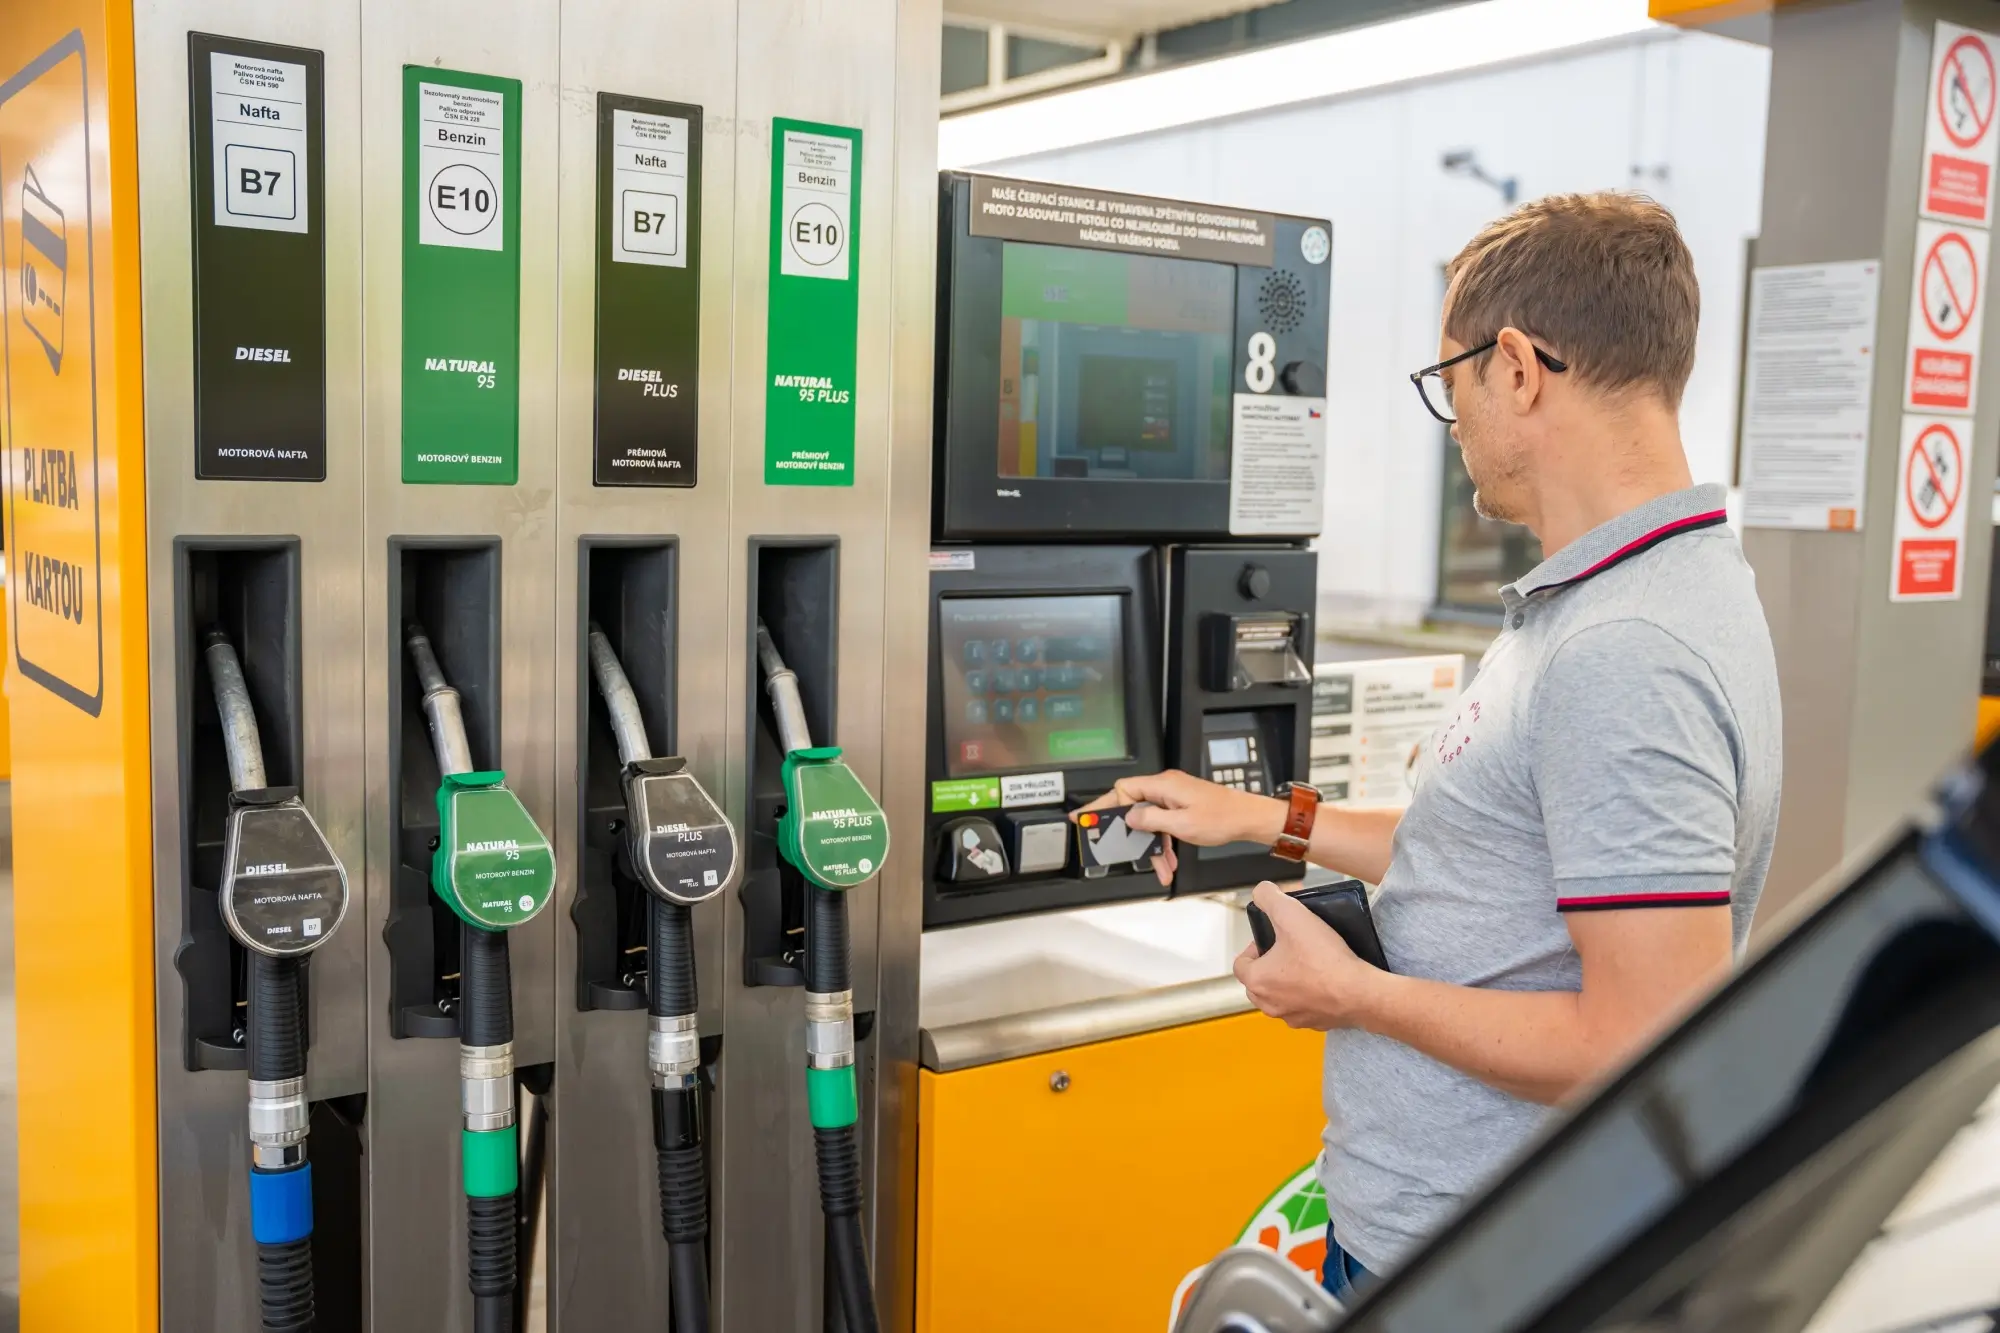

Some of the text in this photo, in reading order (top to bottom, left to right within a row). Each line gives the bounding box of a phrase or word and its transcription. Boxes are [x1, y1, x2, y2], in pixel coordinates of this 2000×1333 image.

[235, 63, 265, 72] Motorová
[233, 70, 284, 82] Palivo odpovídá
[240, 77, 254, 85] ČSN
[424, 90, 460, 100] Bezolovnatý
[240, 103, 280, 121] Nafta
[439, 105, 457, 113] Palivo
[444, 112, 458, 120] ČSN
[438, 129, 486, 145] Benzin
[635, 154, 667, 168] Nafta
[240, 168, 281, 196] B7
[798, 172, 836, 187] Benzin
[437, 185, 490, 212] E10
[992, 187, 1016, 201] NAŠE
[1018, 188, 1057, 206] ČERPACÍ
[1058, 196, 1095, 211] STANICE
[1097, 201, 1107, 212] JE
[983, 202, 1015, 216] PROTO
[1016, 206, 1075, 223] ZASOUVEJTE
[1076, 214, 1109, 228] PISTOLI
[1111, 217, 1124, 229] CO
[634, 210, 666, 235] B7
[796, 221, 838, 245] E10
[235, 347, 291, 363] DIESEL
[424, 358, 496, 373] NATURAL
[1245, 332, 1276, 393] 8
[477, 375, 495, 388] 95
[618, 369, 662, 382] DIESEL
[775, 375, 833, 389] NATURAL
[644, 384, 678, 398] PLUS
[799, 388, 849, 404] 95 PLUS
[218, 448, 308, 460] MOTOROVÁ NAFTA
[418, 453, 502, 464] MOTOROVÝ BENZIN
[627, 448, 667, 458] PRÉMIOVÁ
[792, 451, 829, 460] PRÉMIOVÝ
[612, 458, 681, 469] MOTOROVÁ NAFTA
[776, 461, 845, 471] MOTOROVÝ BENZIN
[24, 447, 79, 511] PLATBA
[25, 550, 83, 625] KARTOU
[812, 808, 858, 820] NATURAL
[833, 816, 872, 828] 95 PLUS
[657, 823, 689, 834] DIESEL
[678, 831, 702, 842] PLUS
[821, 837, 851, 845] MOTOROVÝ
[466, 840, 519, 852] NATURAL
[505, 850, 520, 860] 95
[666, 851, 697, 859] MOTOROVÁ
[245, 864, 290, 875] DIESEL
[823, 863, 849, 872] NATURAL
[475, 869, 535, 880] MOTOROVÝ BENZIN
[254, 892, 322, 905] MOTOROVÁ NAFTA
[482, 900, 512, 908] NATURAL
[267, 926, 292, 935] DIESEL
